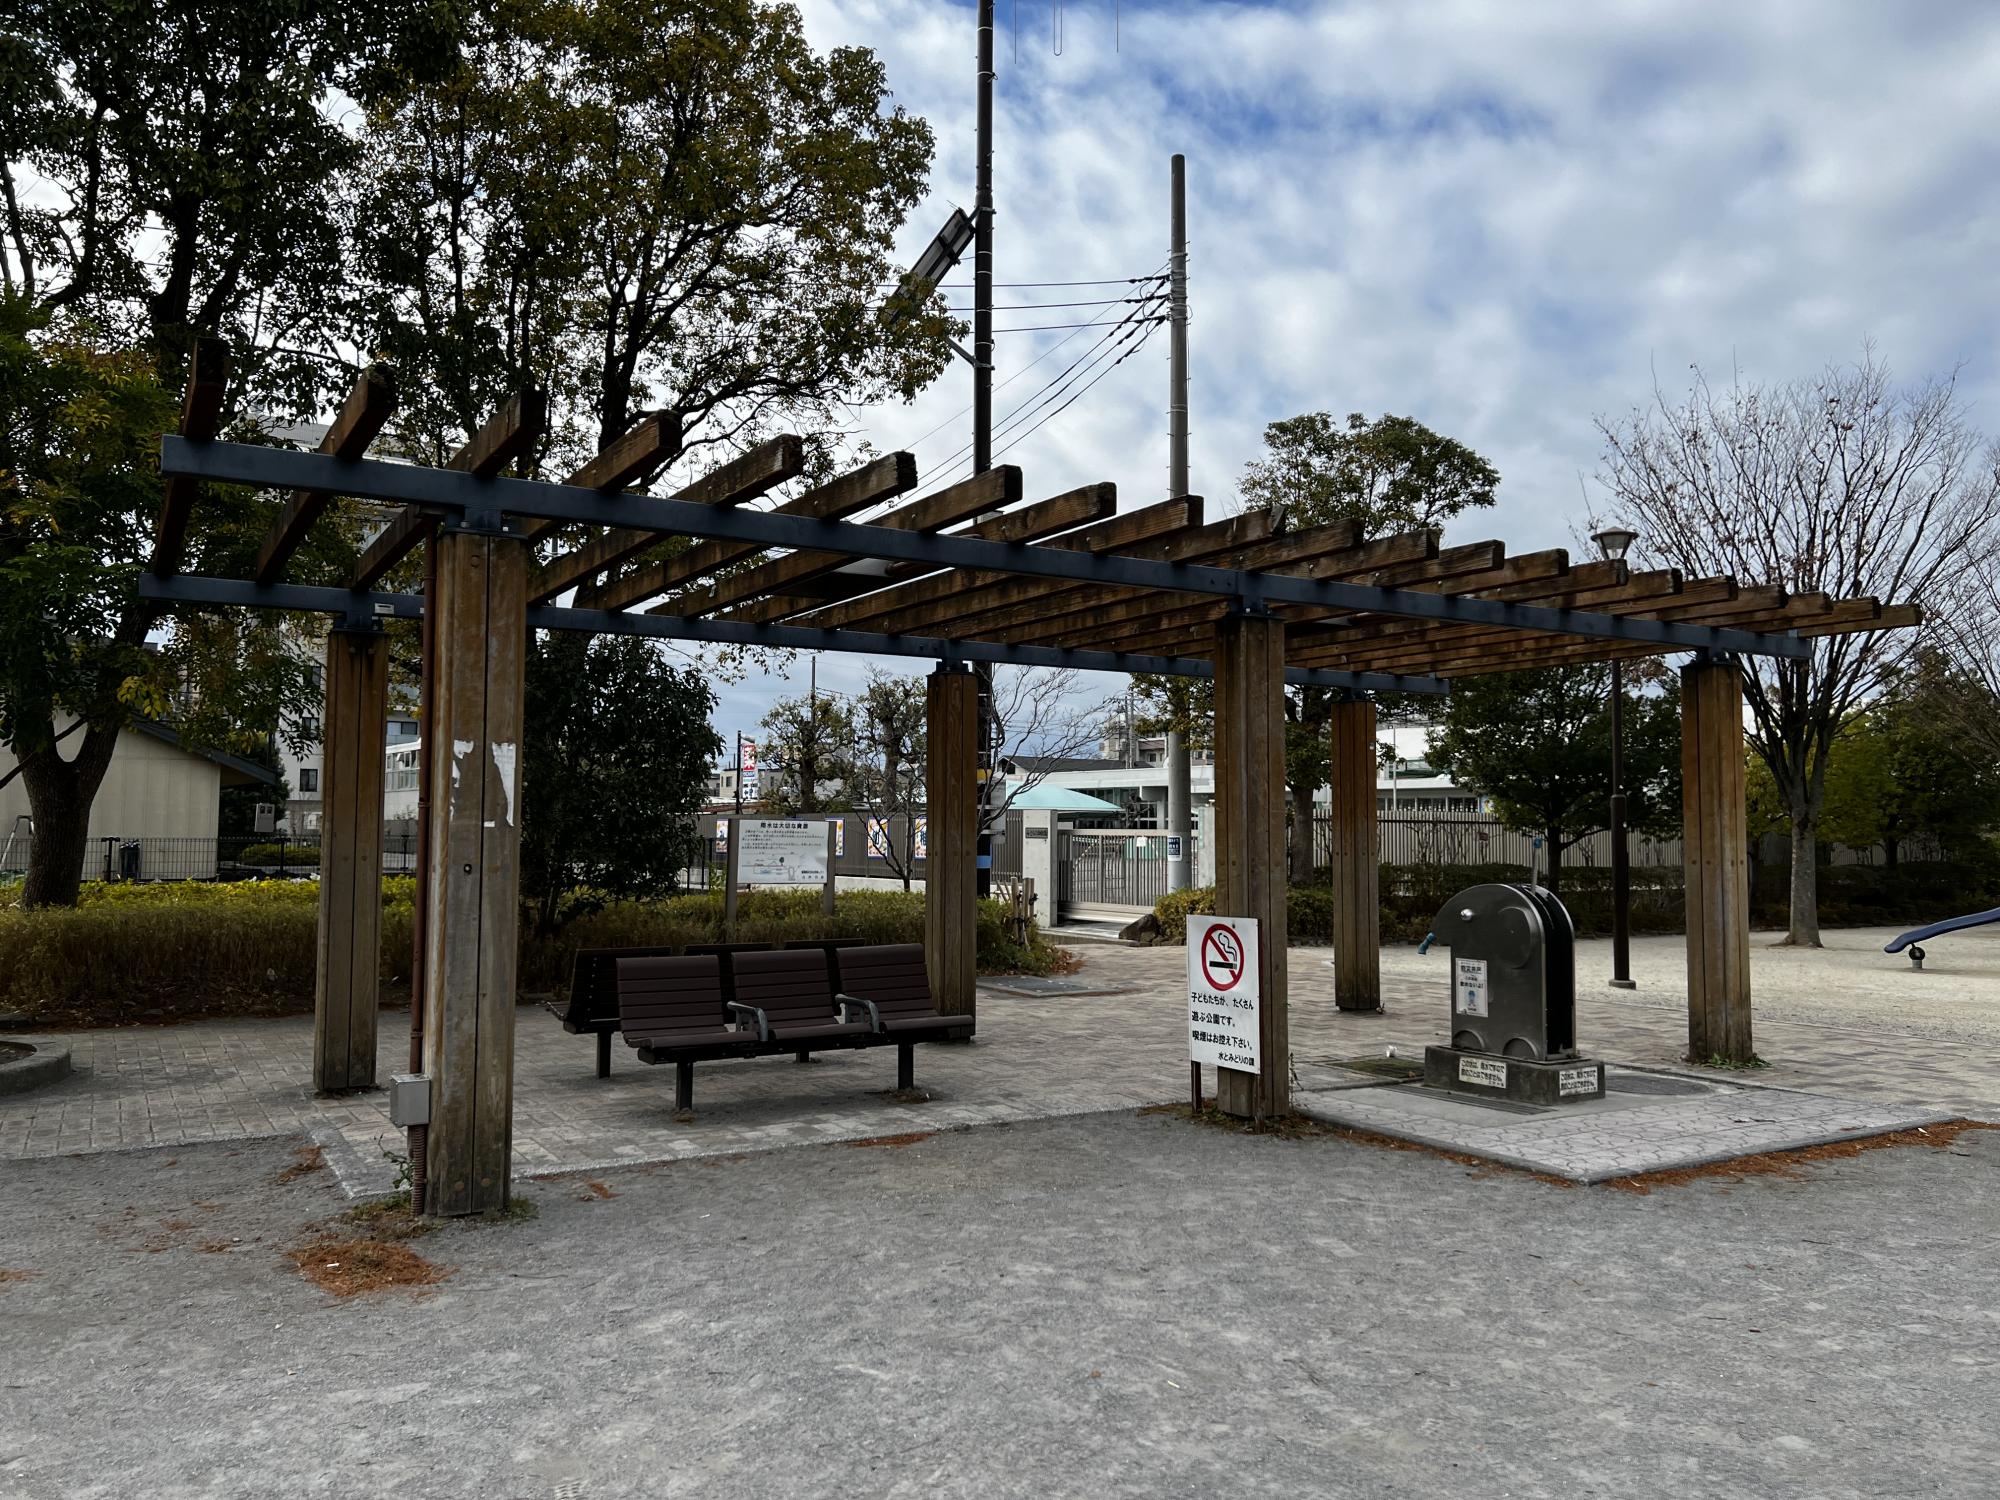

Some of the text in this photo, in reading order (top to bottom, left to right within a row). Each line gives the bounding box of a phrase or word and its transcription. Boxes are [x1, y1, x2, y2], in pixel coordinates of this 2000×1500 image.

[1191, 1010, 1236, 1027] 遊ぶ公園です。
[1192, 1030, 1253, 1051] 喫煙はお控え下さい。
